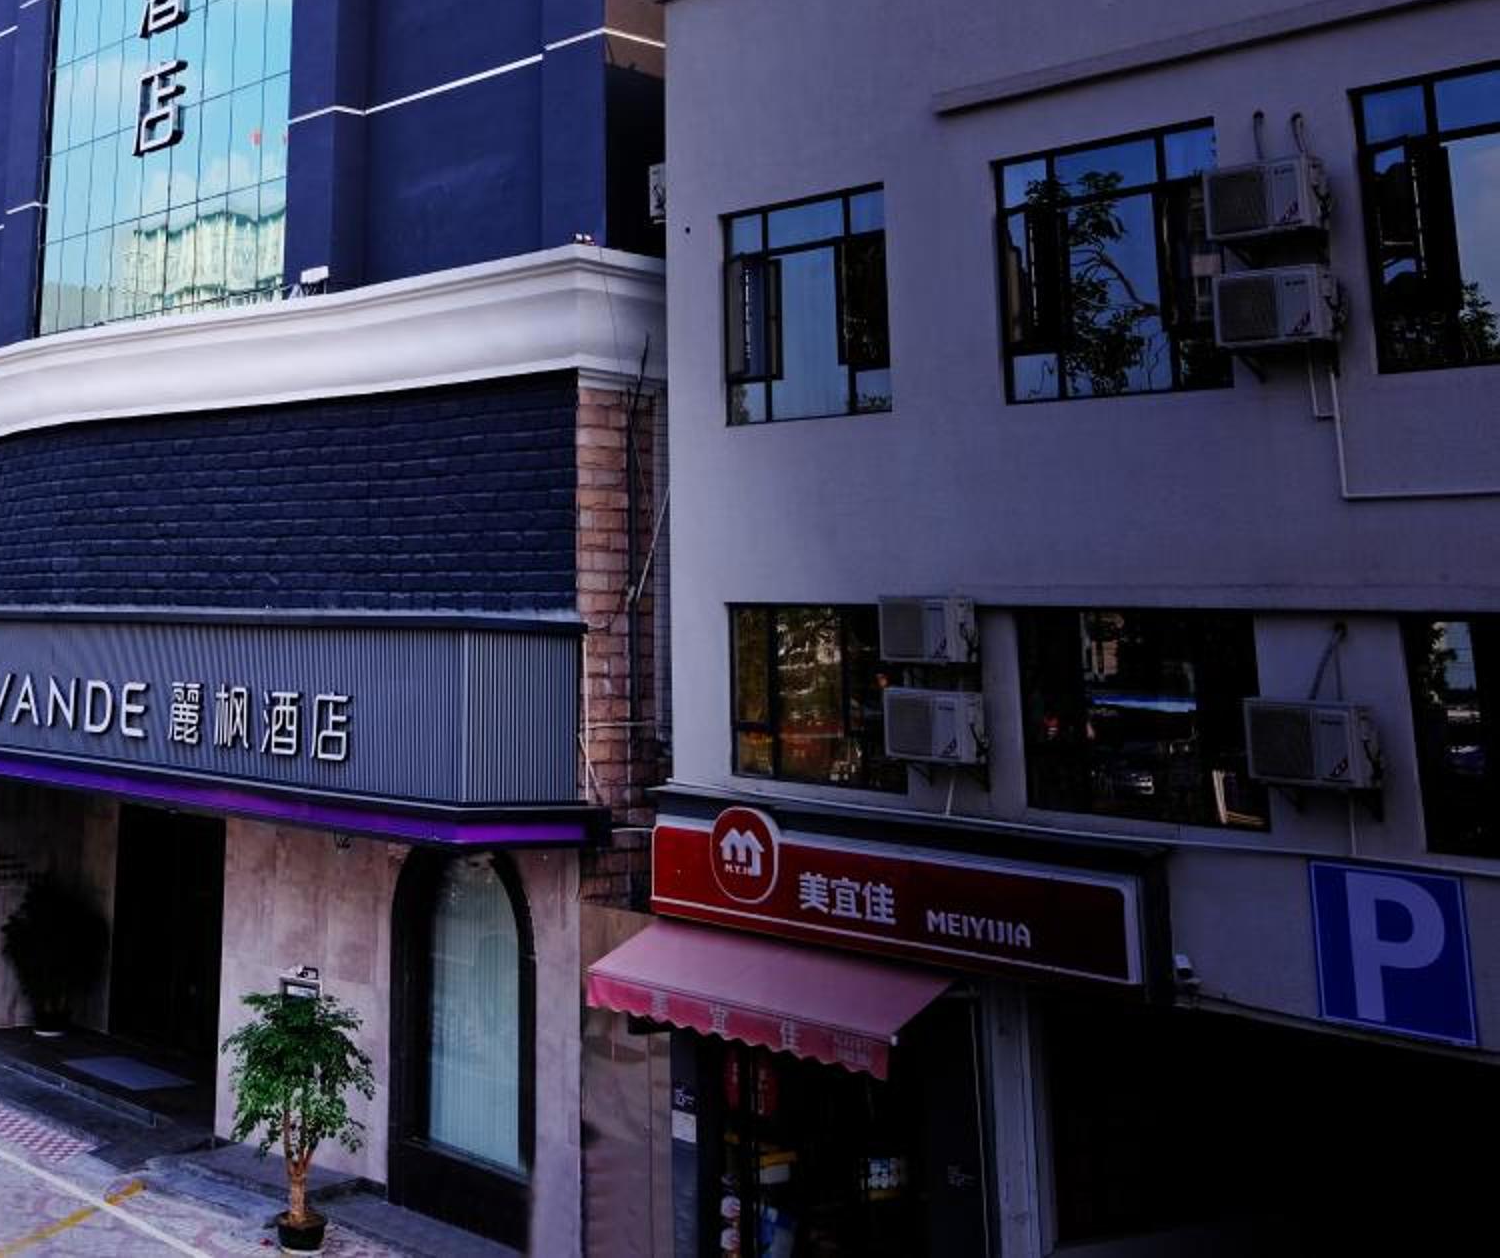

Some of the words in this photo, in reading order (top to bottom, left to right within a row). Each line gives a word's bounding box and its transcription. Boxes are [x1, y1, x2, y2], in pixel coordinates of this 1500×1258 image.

[796, 871, 897, 926] 美宜佳
[926, 909, 1032, 950] MEIYIJIA
[1345, 871, 1446, 1022] P
